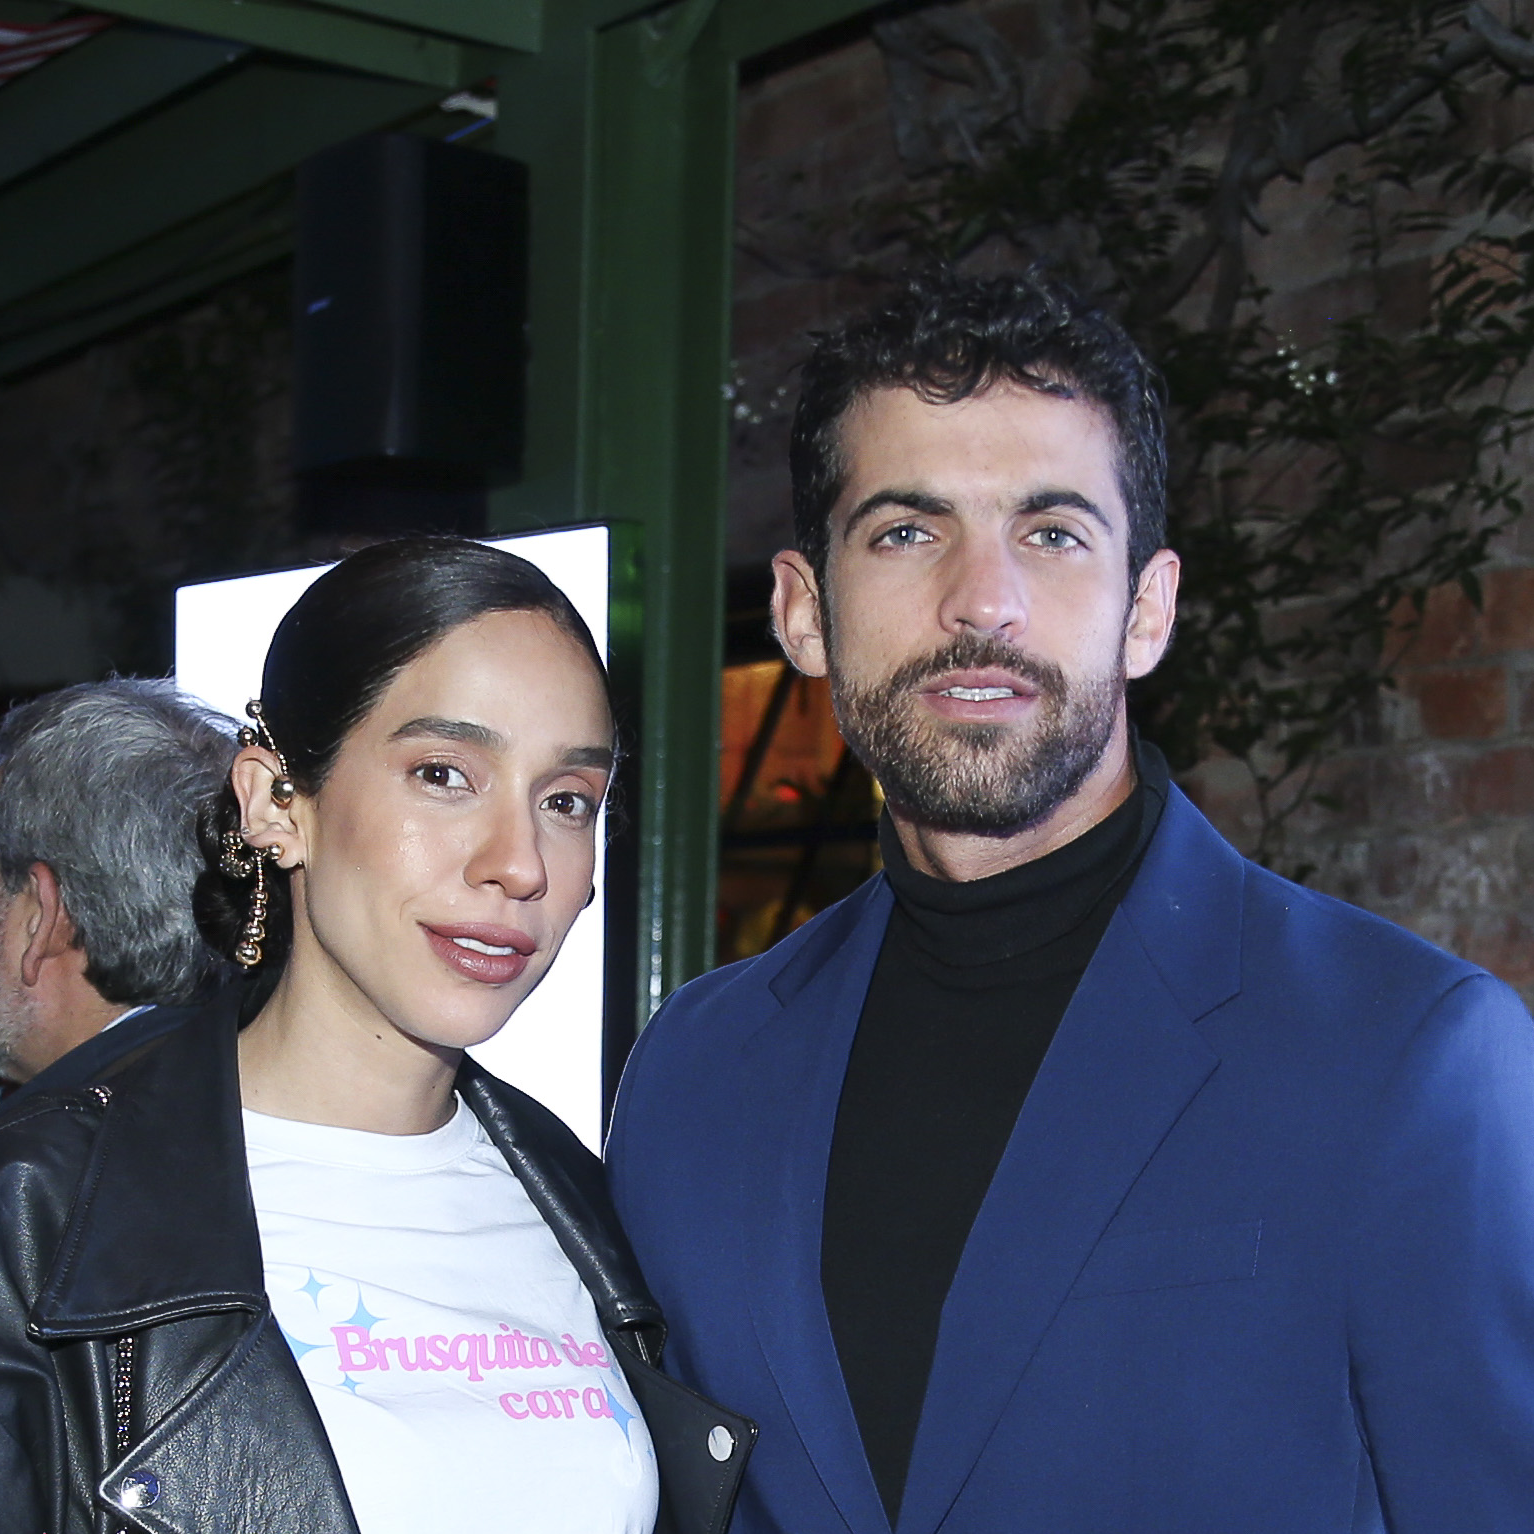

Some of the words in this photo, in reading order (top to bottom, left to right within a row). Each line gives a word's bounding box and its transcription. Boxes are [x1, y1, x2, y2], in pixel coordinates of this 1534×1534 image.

[330, 1323, 561, 1381] Brusquita
[561, 1334, 611, 1368] de
[499, 1386, 614, 1420] cara
